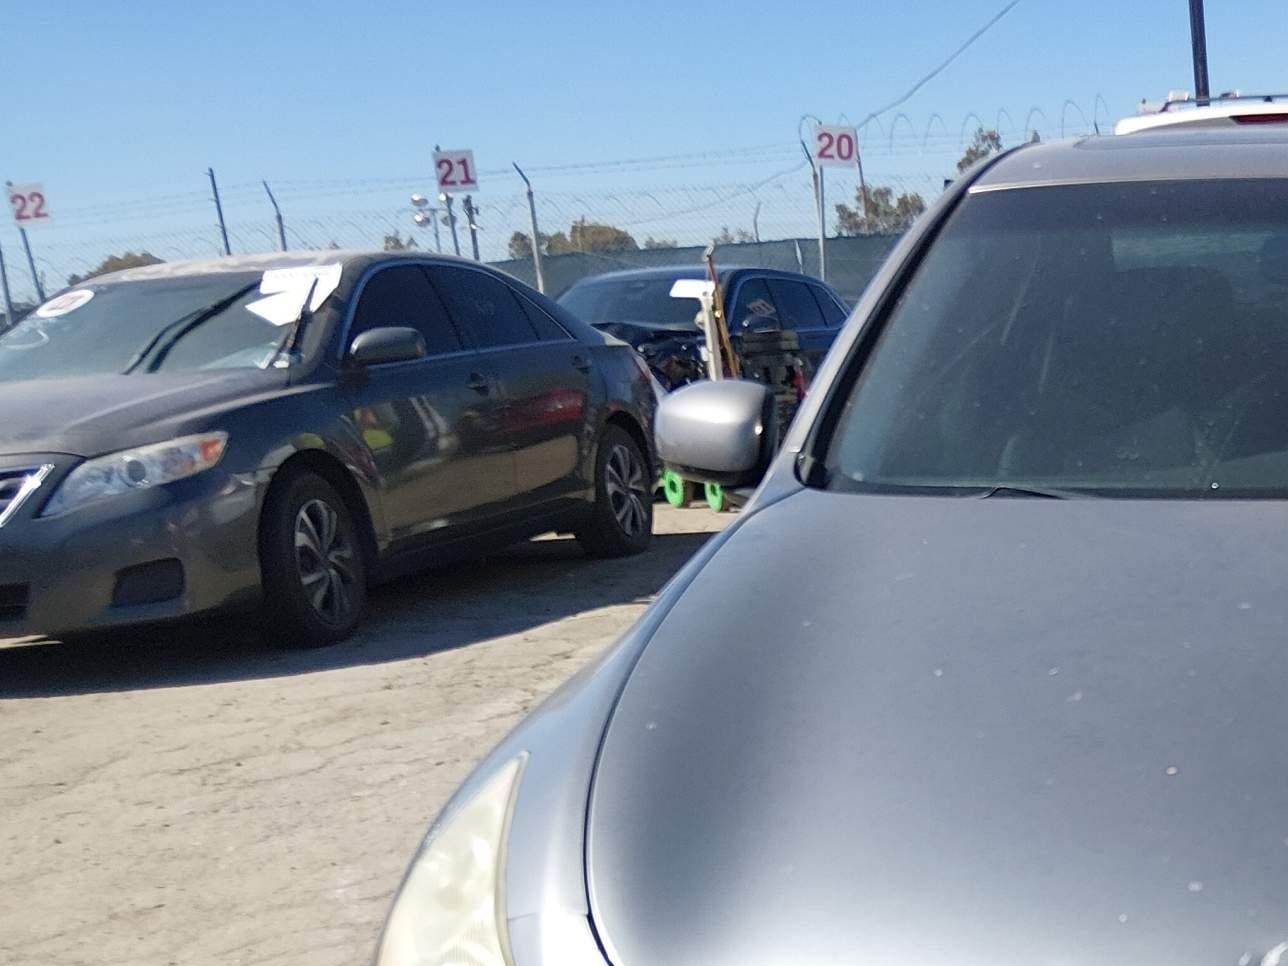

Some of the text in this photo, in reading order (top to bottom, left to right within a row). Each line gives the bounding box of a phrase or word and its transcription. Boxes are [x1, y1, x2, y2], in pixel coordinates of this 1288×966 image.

[817, 132, 853, 160] 20
[436, 158, 476, 186] 21
[10, 192, 48, 220] 22
